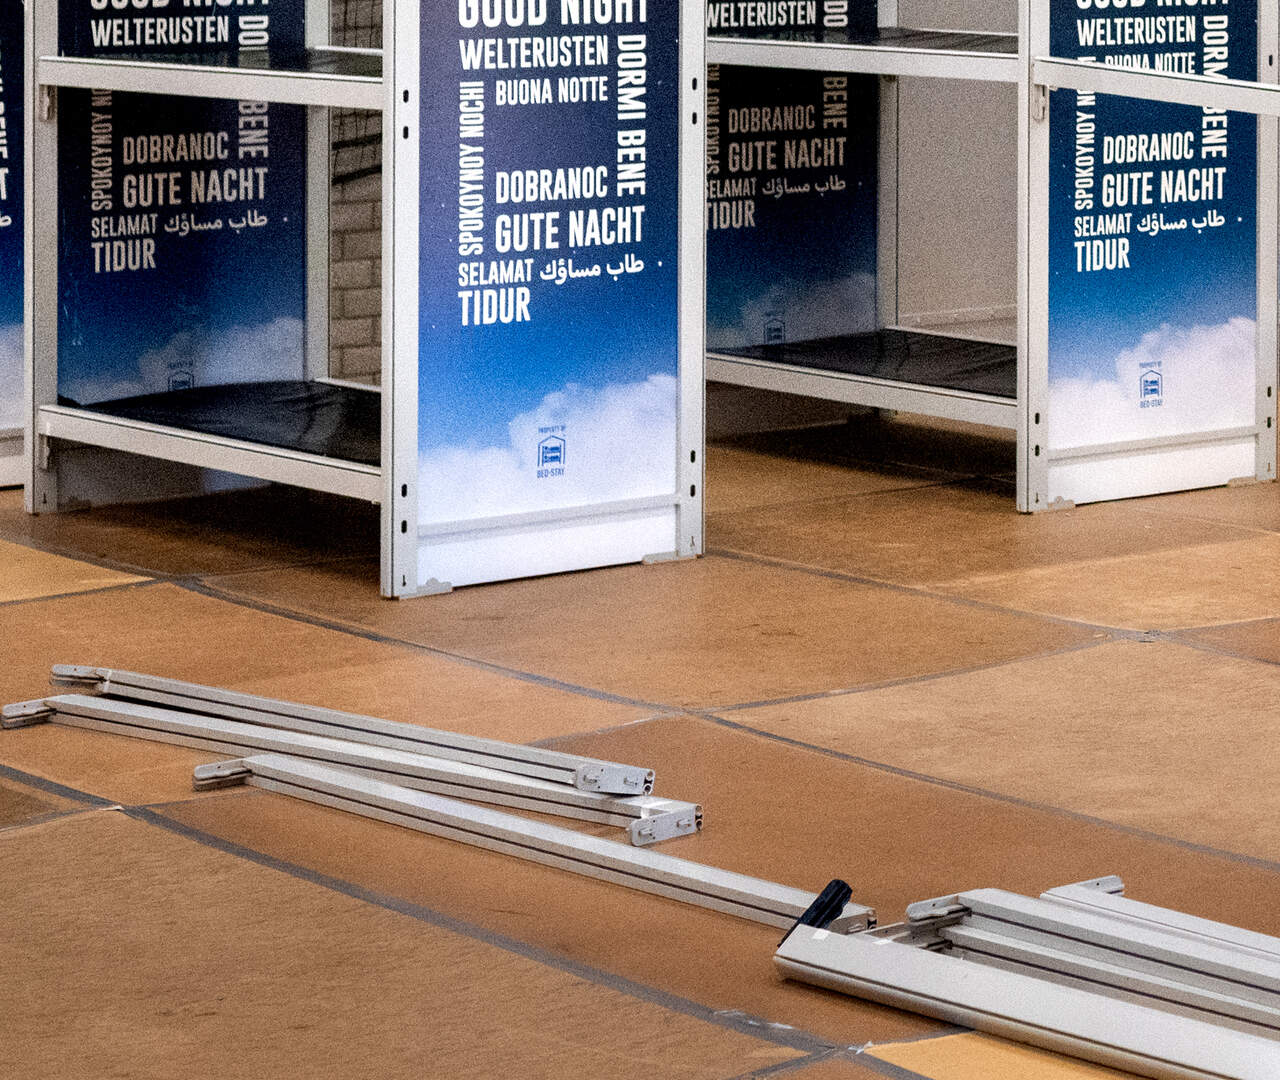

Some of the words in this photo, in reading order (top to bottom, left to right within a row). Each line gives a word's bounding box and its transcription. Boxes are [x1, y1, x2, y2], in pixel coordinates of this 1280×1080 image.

[91, 16, 229, 47] WELTERUSTEN
[708, 1, 816, 27] WELTERUSTEN
[1077, 16, 1196, 46] WELTERUSTEN
[459, 35, 608, 70] WELTERUSTEN
[1203, 15, 1228, 79] DORM
[496, 79, 553, 105] BUONA
[559, 76, 608, 102] NOTTE
[617, 35, 647, 120] DORMI
[459, 81, 484, 138] NOCHI
[728, 105, 815, 133] DOBRANOC
[823, 77, 847, 129] BENE
[91, 112, 113, 211] SPOKOYNOY
[123, 132, 229, 164] DOBRANOC
[617, 129, 646, 197] BENE
[728, 141, 777, 172] GUTE
[785, 137, 847, 169] NACHT
[1075, 111, 1095, 211] SPOKOYNOY
[1103, 131, 1194, 164] DOBRANOC
[123, 172, 182, 208] GUTE
[191, 168, 269, 203] NACHT
[459, 144, 484, 256] SPOKOYNOY
[496, 166, 608, 204] DOBRANOC
[1102, 172, 1153, 207] GUTE
[1160, 167, 1226, 203] NACHT
[91, 213, 158, 238] SELAMAT
[495, 212, 559, 253] GUTE
[569, 205, 645, 247] NACHT
[1075, 213, 1132, 237] SELAMAT
[91, 238, 156, 273] TIDUR
[606, 254, 644, 281] طاب
[1074, 238, 1130, 272] TIDUR
[458, 259, 534, 287] SELAMAT
[458, 287, 530, 326] TIDUR
